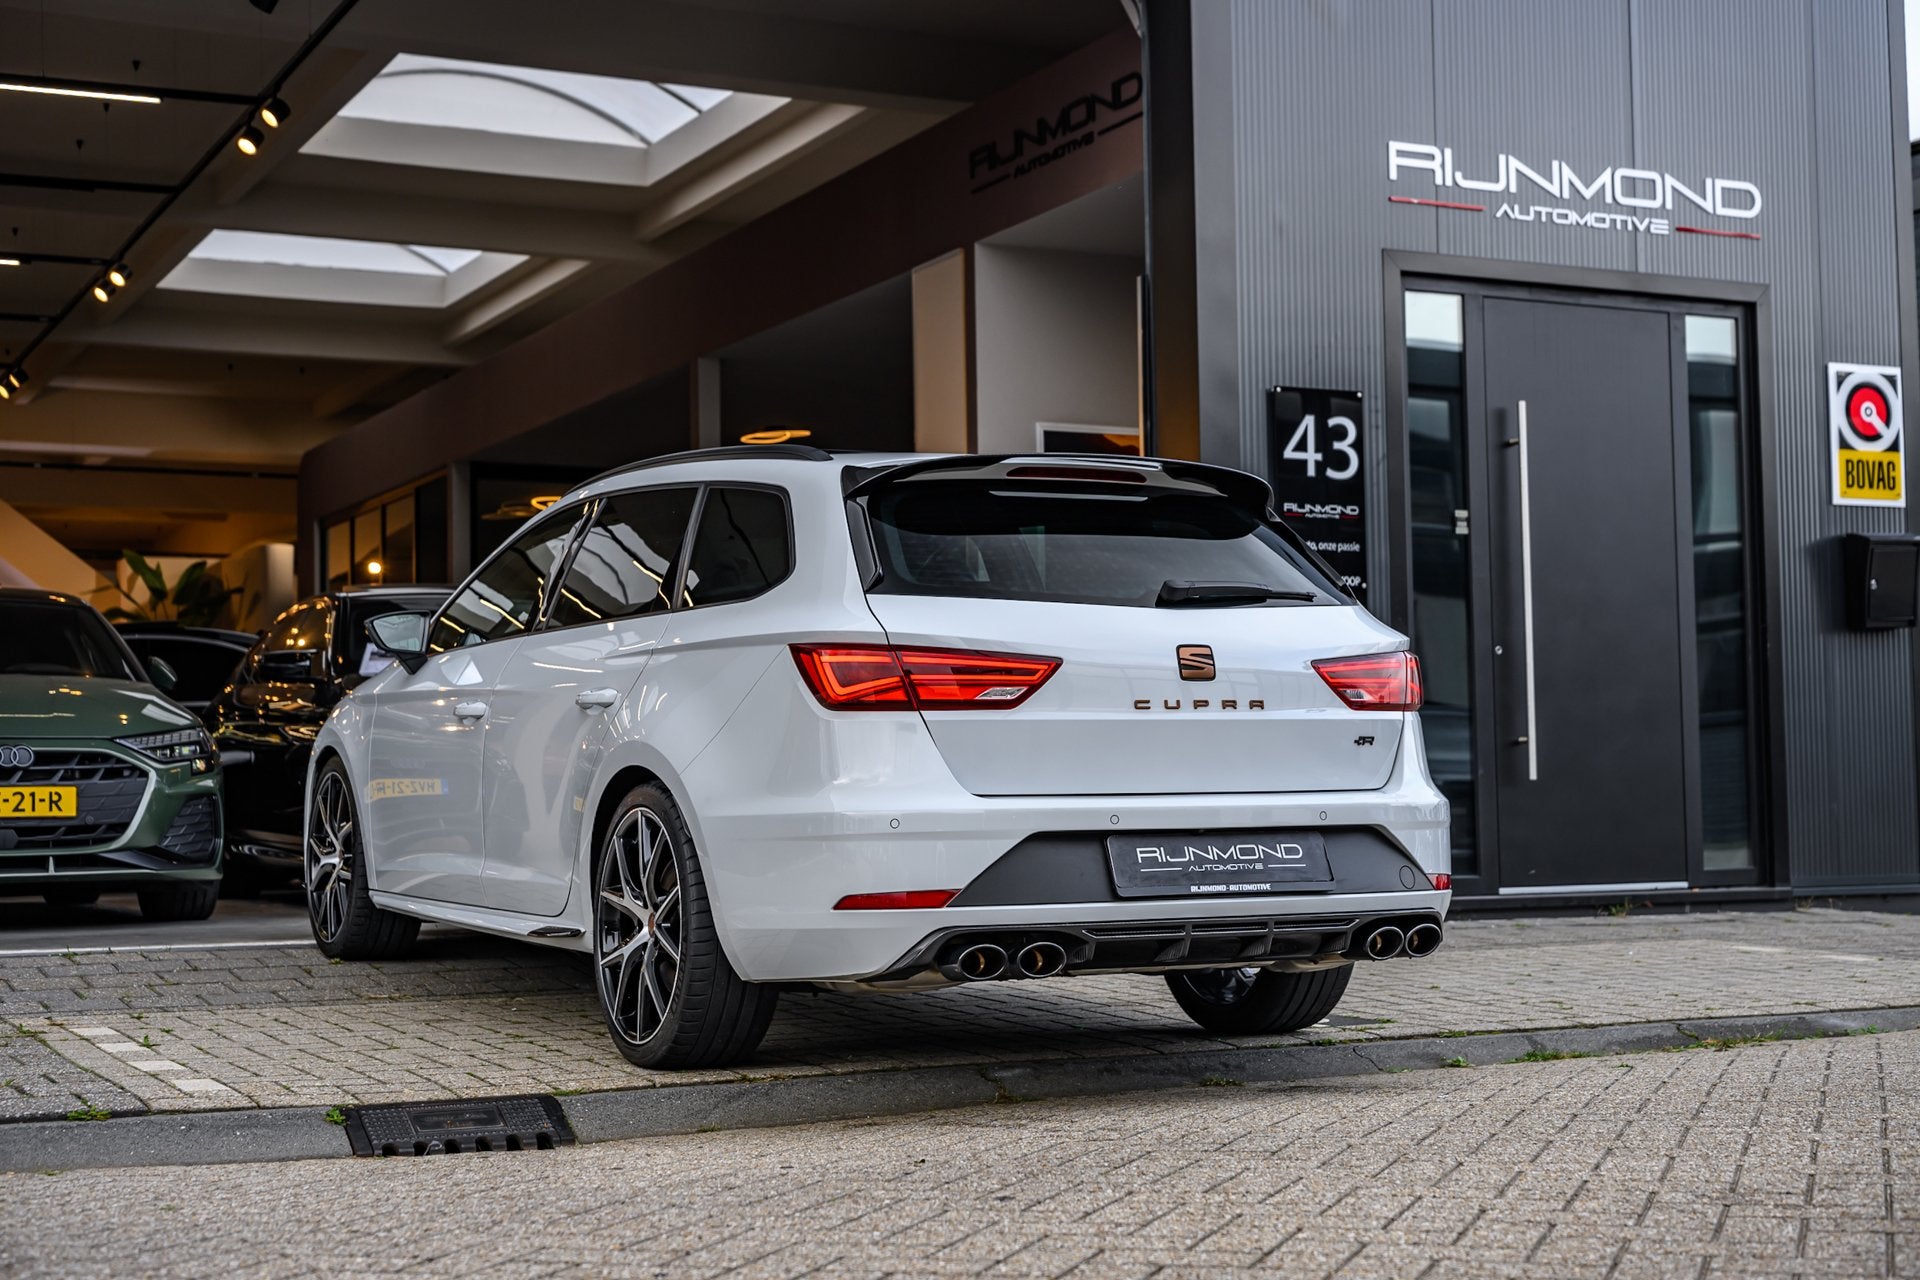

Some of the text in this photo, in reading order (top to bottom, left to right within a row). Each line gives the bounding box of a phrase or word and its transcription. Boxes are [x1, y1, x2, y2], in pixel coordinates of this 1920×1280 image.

[1387, 140, 1762, 219] RIJNMOND
[1495, 202, 1670, 235] AUTOMOTIVE
[1283, 414, 1359, 480] 43
[1845, 459, 1896, 491] BOVAG
[1283, 502, 1359, 516] RIJNMOND
[1318, 542, 1337, 551] onze
[1337, 541, 1361, 553] passie
[1133, 699, 1265, 710] CUPRA
[0, 791, 63, 812] -21-R
[1136, 843, 1303, 863] RIJNMOND
[1188, 862, 1264, 872] AUTOMOTIVE
